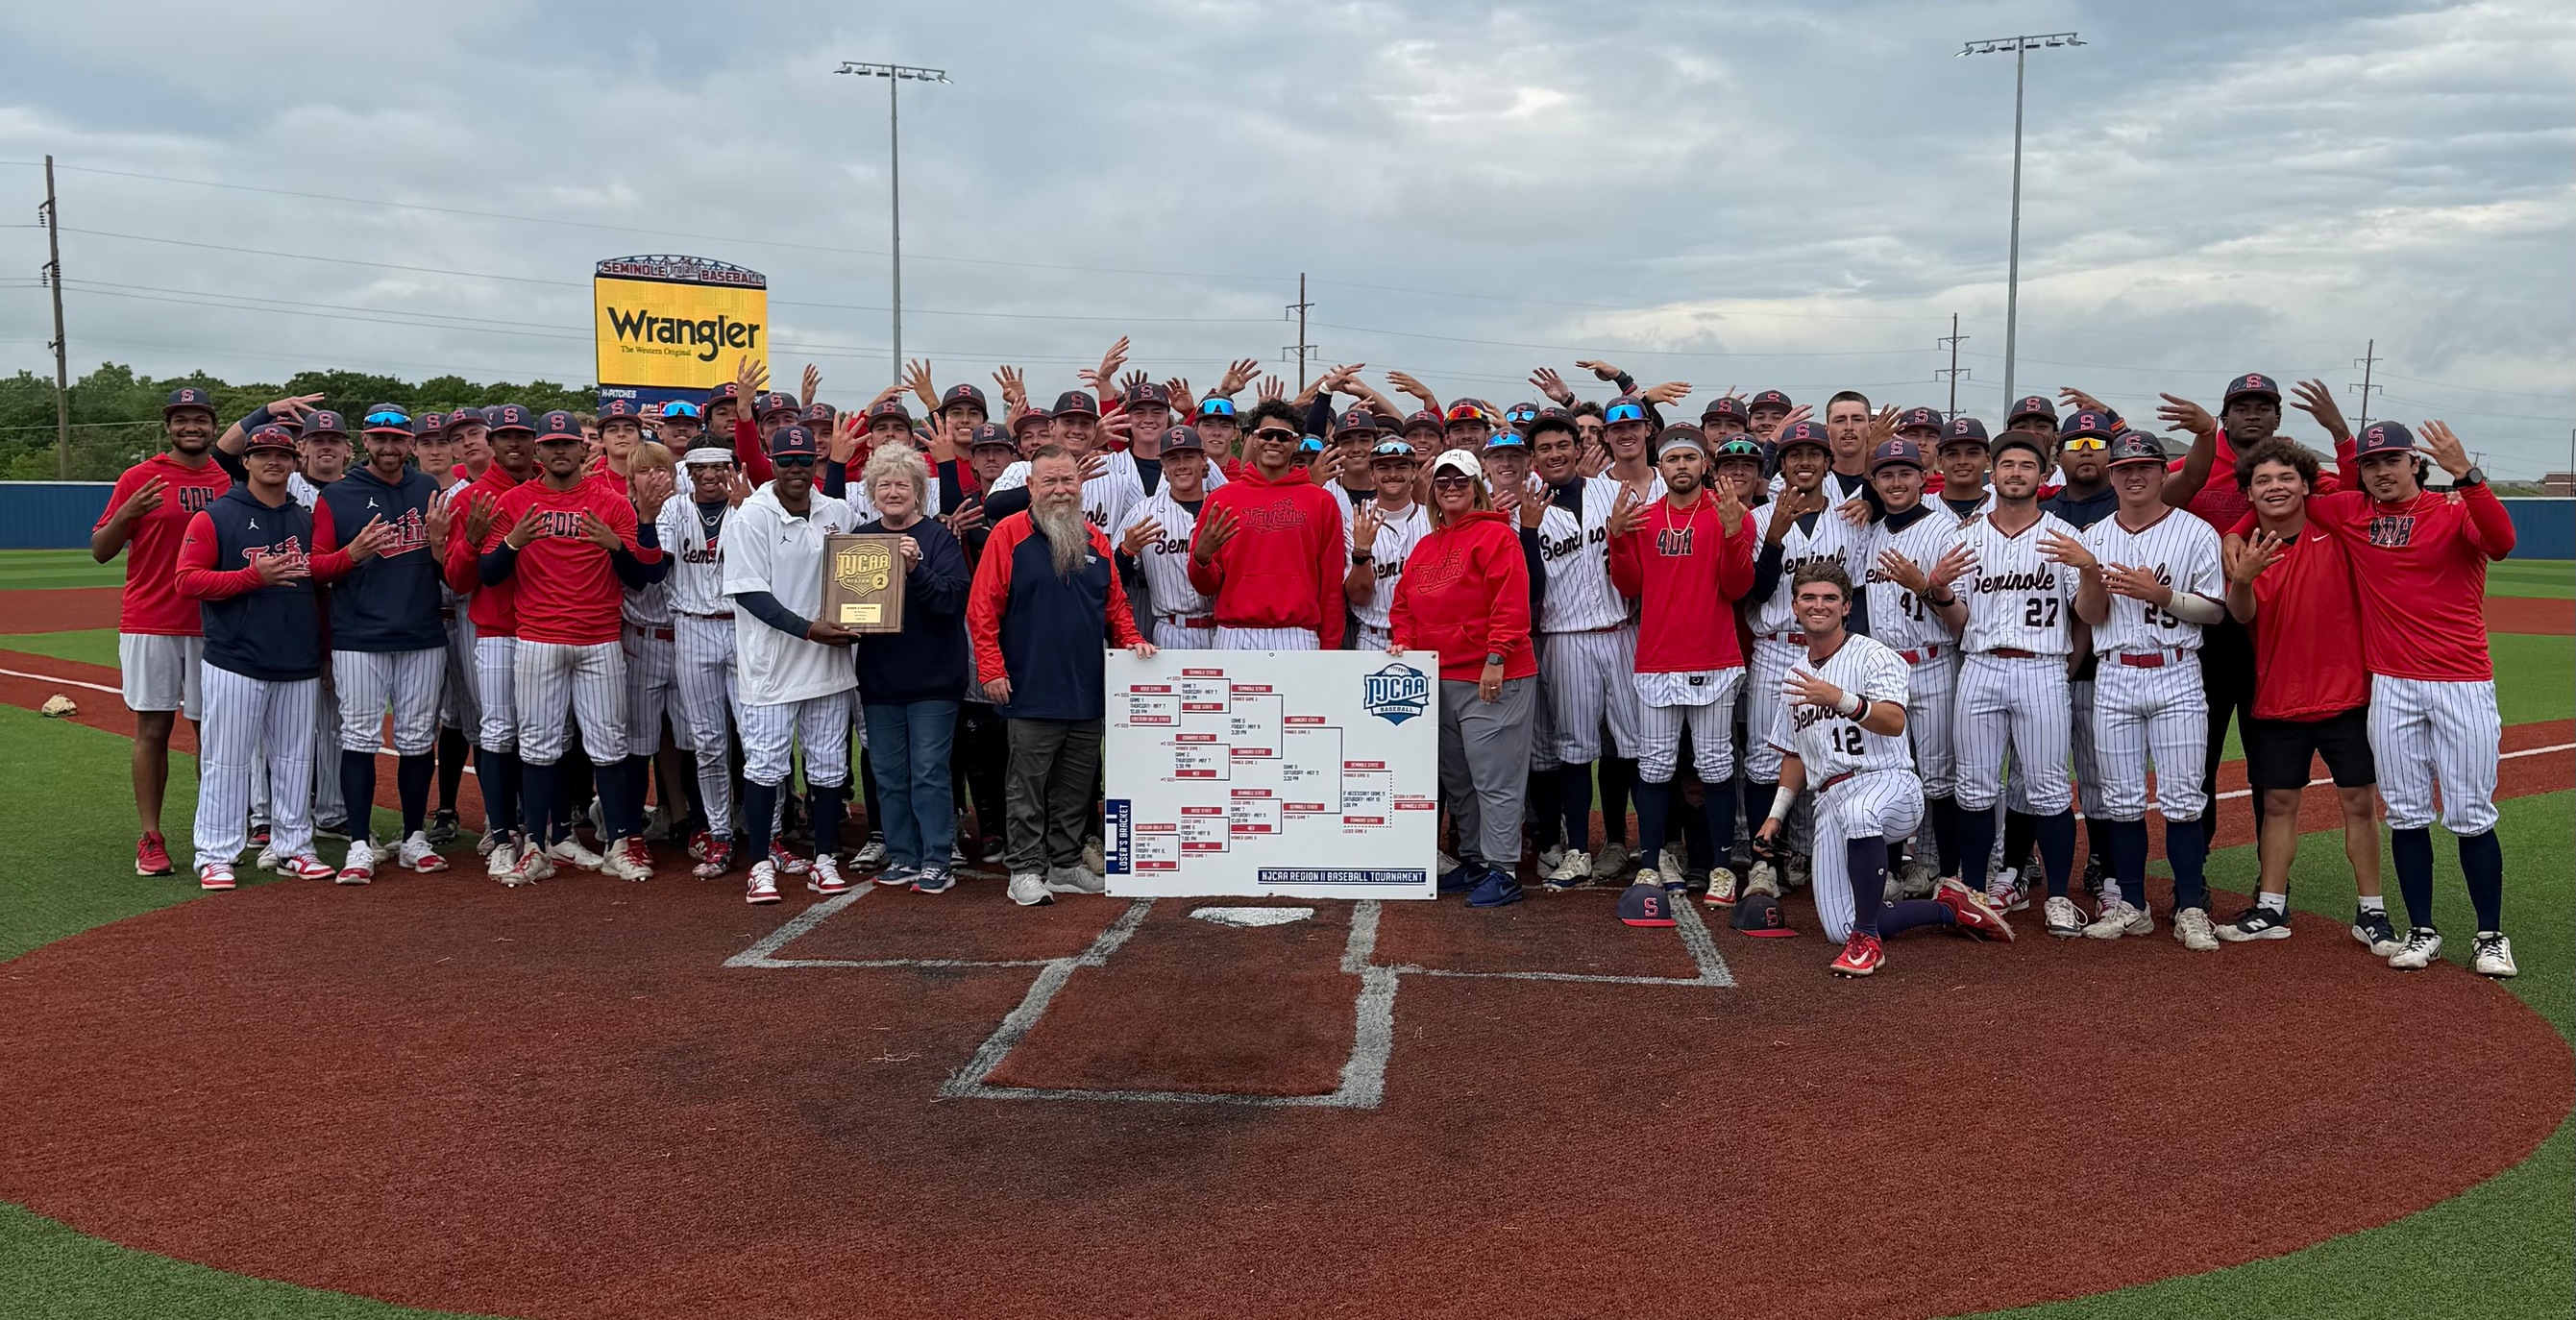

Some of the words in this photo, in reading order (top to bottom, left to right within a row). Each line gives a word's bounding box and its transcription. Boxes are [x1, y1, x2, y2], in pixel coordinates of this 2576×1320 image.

[603, 261, 667, 277] SEMINOLE
[700, 269, 763, 284] BASEBALL
[606, 306, 760, 362] Wrangler
[636, 346, 662, 354] Western
[663, 347, 691, 357] Original
[2246, 374, 2262, 388] S
[958, 385, 971, 396] S
[1141, 385, 1153, 398] S
[771, 395, 784, 408] S
[1071, 394, 1084, 408] S
[1719, 400, 1732, 413] S
[2026, 396, 2040, 411] S
[319, 414, 333, 428] S
[427, 415, 440, 428] S
[504, 407, 518, 423] S
[551, 415, 565, 431] S
[1346, 412, 1360, 427] S
[1914, 409, 1928, 423] S
[2081, 414, 2096, 430] S
[1795, 424, 1809, 440] S
[1955, 419, 1968, 434] S
[789, 429, 803, 446] S
[1172, 429, 1184, 445] S
[2368, 427, 2384, 447] S
[1890, 440, 1903, 455] S
[1656, 527, 1694, 556] 4DH
[837, 554, 889, 578] NJCAA
[1900, 592, 1924, 621] 41
[2025, 598, 2058, 627] 27
[1367, 678, 1425, 705] NJCAA
[1832, 726, 1864, 756] 12
[1119, 805, 1128, 837] BRACKET
[1119, 840, 1128, 870] LOSER'S
[1262, 871, 1288, 881] NJCAA
[1290, 872, 1319, 881] REGION
[1320, 872, 1325, 881] II
[1327, 872, 1368, 882] BASEBALL
[1370, 872, 1423, 882] TOURNAMENT
[1644, 897, 1659, 917] S
[1765, 907, 1779, 926] S
